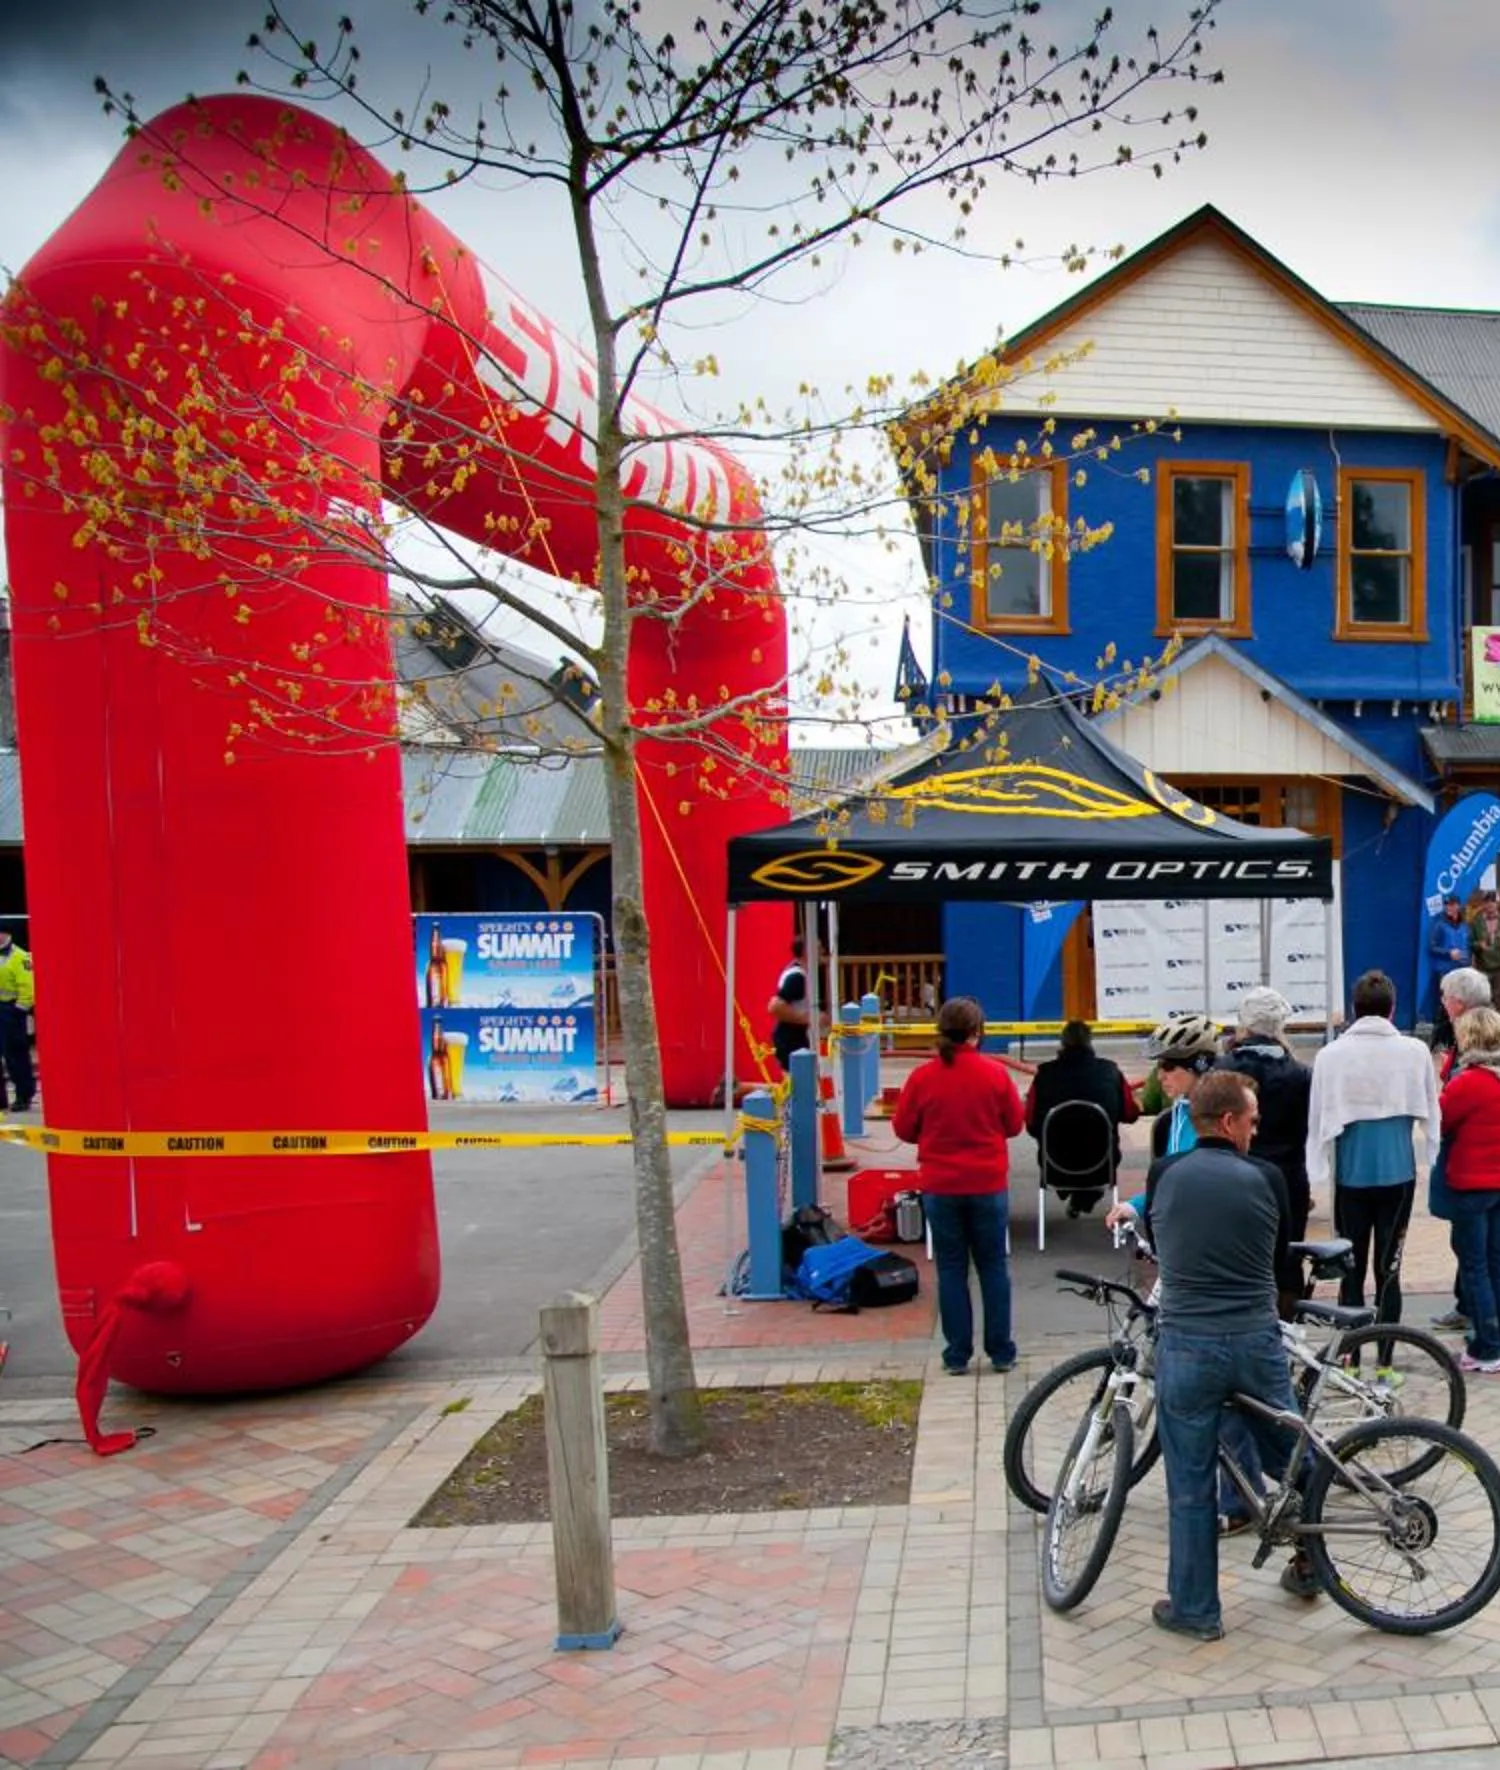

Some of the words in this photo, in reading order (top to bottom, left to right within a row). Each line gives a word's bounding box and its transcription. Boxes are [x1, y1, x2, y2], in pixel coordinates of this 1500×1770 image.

[889, 861, 1092, 880] SMITH
[477, 933, 575, 959] SUMMIT
[479, 1027, 577, 1053] SUMMIT
[83, 1137, 125, 1150] CAUTION
[167, 1137, 224, 1150] CAUTION
[273, 1135, 327, 1149] CAUTION
[367, 1136, 417, 1148] CAUTION
